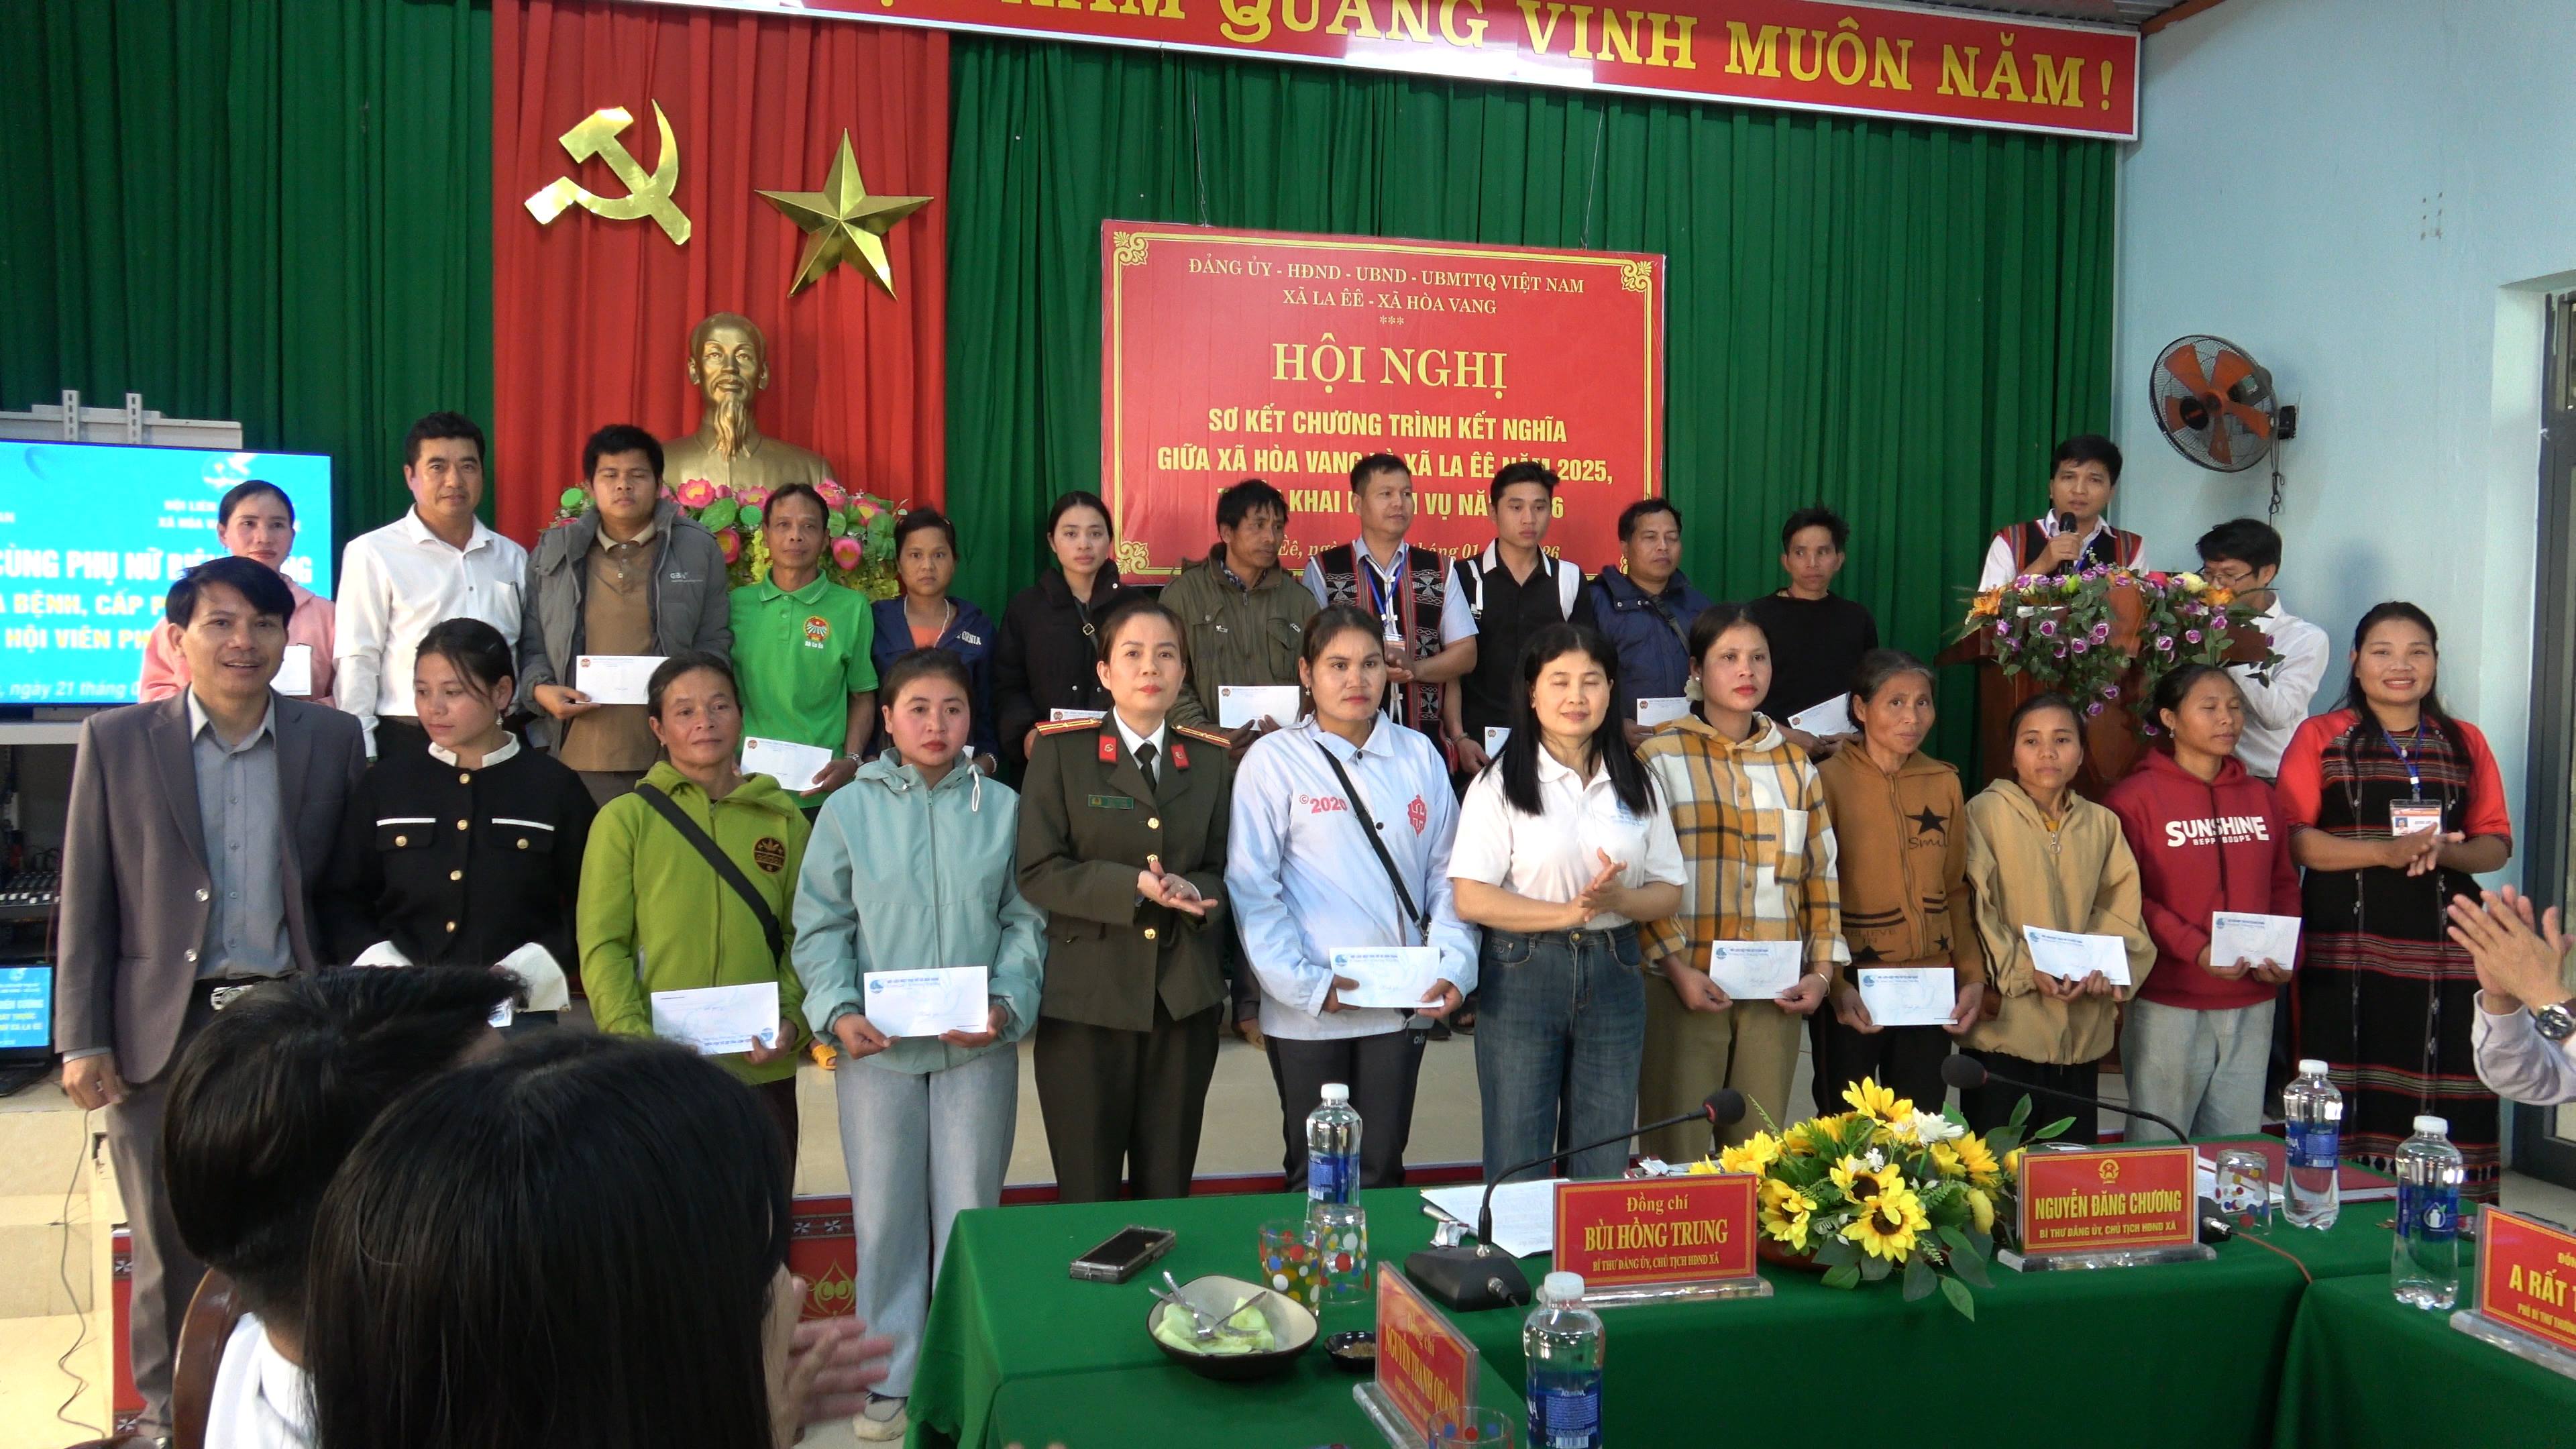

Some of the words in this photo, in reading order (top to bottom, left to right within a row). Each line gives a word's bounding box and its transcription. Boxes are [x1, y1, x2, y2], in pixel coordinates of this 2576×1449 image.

[1517, 0, 1697, 69] VINH
[1725, 17, 1913, 91] MUÔN
[1937, 30, 2084, 107] NĂM
[1189, 253, 1242, 275] ĐẢNG
[1248, 256, 1272, 276] ỦY
[1287, 264, 1340, 279] HĐND
[1356, 266, 1407, 283] UBND
[1421, 271, 1497, 290] UBMTTQ
[1501, 272, 1541, 294] VIỆT
[1546, 278, 1584, 293] NAM
[1283, 286, 1308, 305] XÃ
[1313, 290, 1336, 306] LA
[1341, 288, 1364, 307] ÊÊ
[1378, 291, 1402, 309] XÃ
[1407, 293, 1444, 311] HÒA
[1448, 298, 1497, 314] VANG
[1273, 332, 1366, 394] HỘI
[1380, 347, 1507, 399] NGHỊ
[1208, 407, 1239, 432] SƠ
[1245, 402, 1285, 433] KẾT
[1293, 410, 1381, 436] CHƯƠNG
[1389, 410, 1451, 439] TRÌNH
[1458, 409, 1497, 440] KẾT
[1503, 415, 1567, 443] NGHĨA
[1157, 443, 1210, 471] GIỮA
[1217, 443, 1247, 472] XÃ
[1254, 443, 1299, 473] HÒA
[1404, 449, 1432, 477] XÃ
[1439, 454, 1464, 477] LA
[1470, 451, 1495, 478] ÊÊ
[1558, 458, 1613, 484] 2025,
[1289, 489, 1340, 513] KHAI
[1425, 493, 1451, 520] VỤ
[1459, 490, 1491, 516] NĂ
[0, 542, 59, 578] ÙNG
[66, 549, 118, 586] PHỤ
[5, 624, 47, 653] HỘI
[55, 624, 110, 649] VIÊN
[118, 630, 150, 649] PH
[2165, 816, 2269, 847] SUNSHINE
[1627, 1192, 1664, 1214] Đồng
[1668, 1194, 1688, 1210] chí
[2035, 1188, 2088, 1220] NGUYỄN
[2091, 1190, 2126, 1216] ĐĂNG
[2129, 1189, 2182, 1214] CHƯƠNG
[1584, 1218, 1613, 1252] BÙI
[1670, 1219, 1728, 1246] TRUNG
[2509, 1264, 2523, 1292] A
[2528, 1269, 2567, 1307] RẤT
